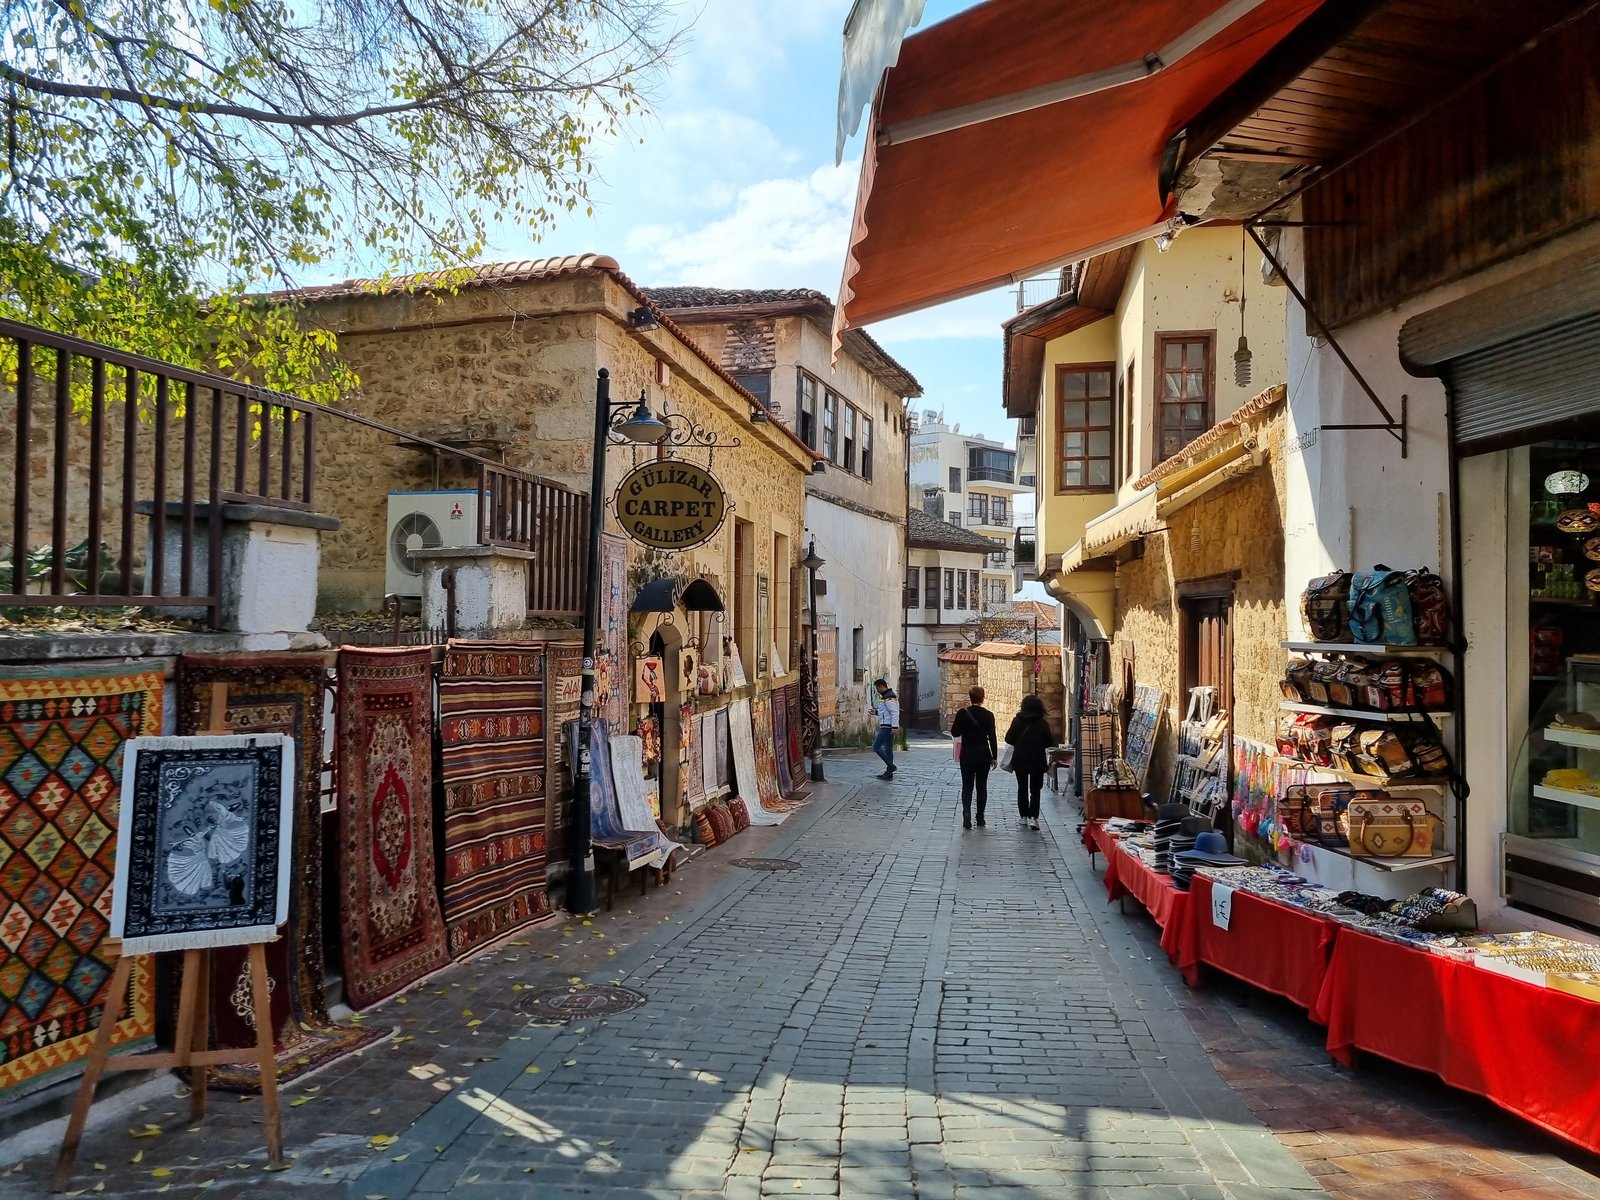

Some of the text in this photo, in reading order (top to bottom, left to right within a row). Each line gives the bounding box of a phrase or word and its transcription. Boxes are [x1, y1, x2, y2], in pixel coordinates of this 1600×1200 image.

[629, 465, 713, 499] GÜLİZAR
[625, 499, 716, 518] CARPET
[633, 520, 705, 543] GALLERY
